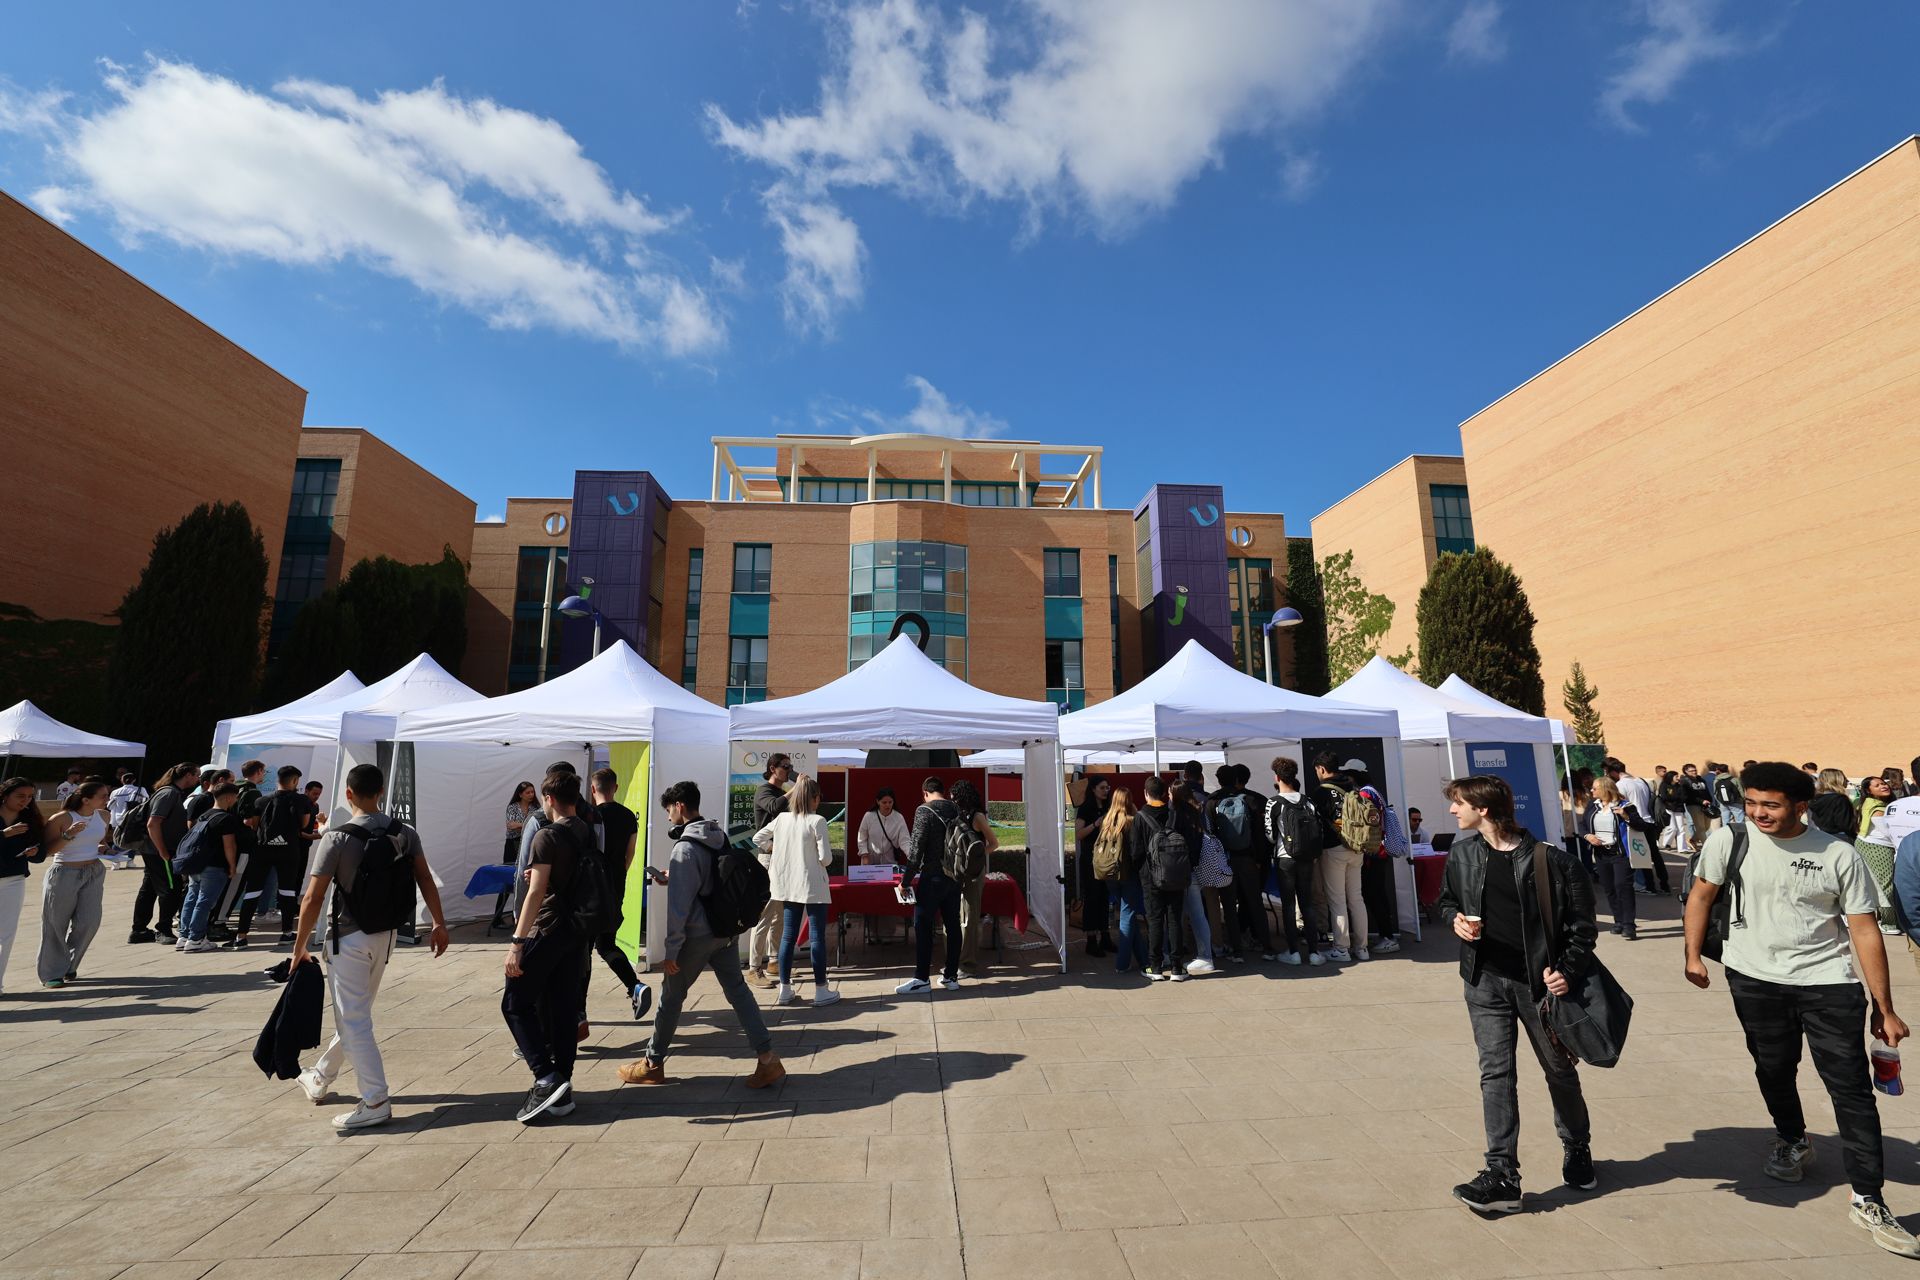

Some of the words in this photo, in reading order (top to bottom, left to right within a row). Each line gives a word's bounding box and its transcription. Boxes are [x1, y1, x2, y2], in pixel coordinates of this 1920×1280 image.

[1476, 758, 1505, 767] transfer
[733, 811, 741, 819] EL
[1790, 861, 1823, 871] Again!
